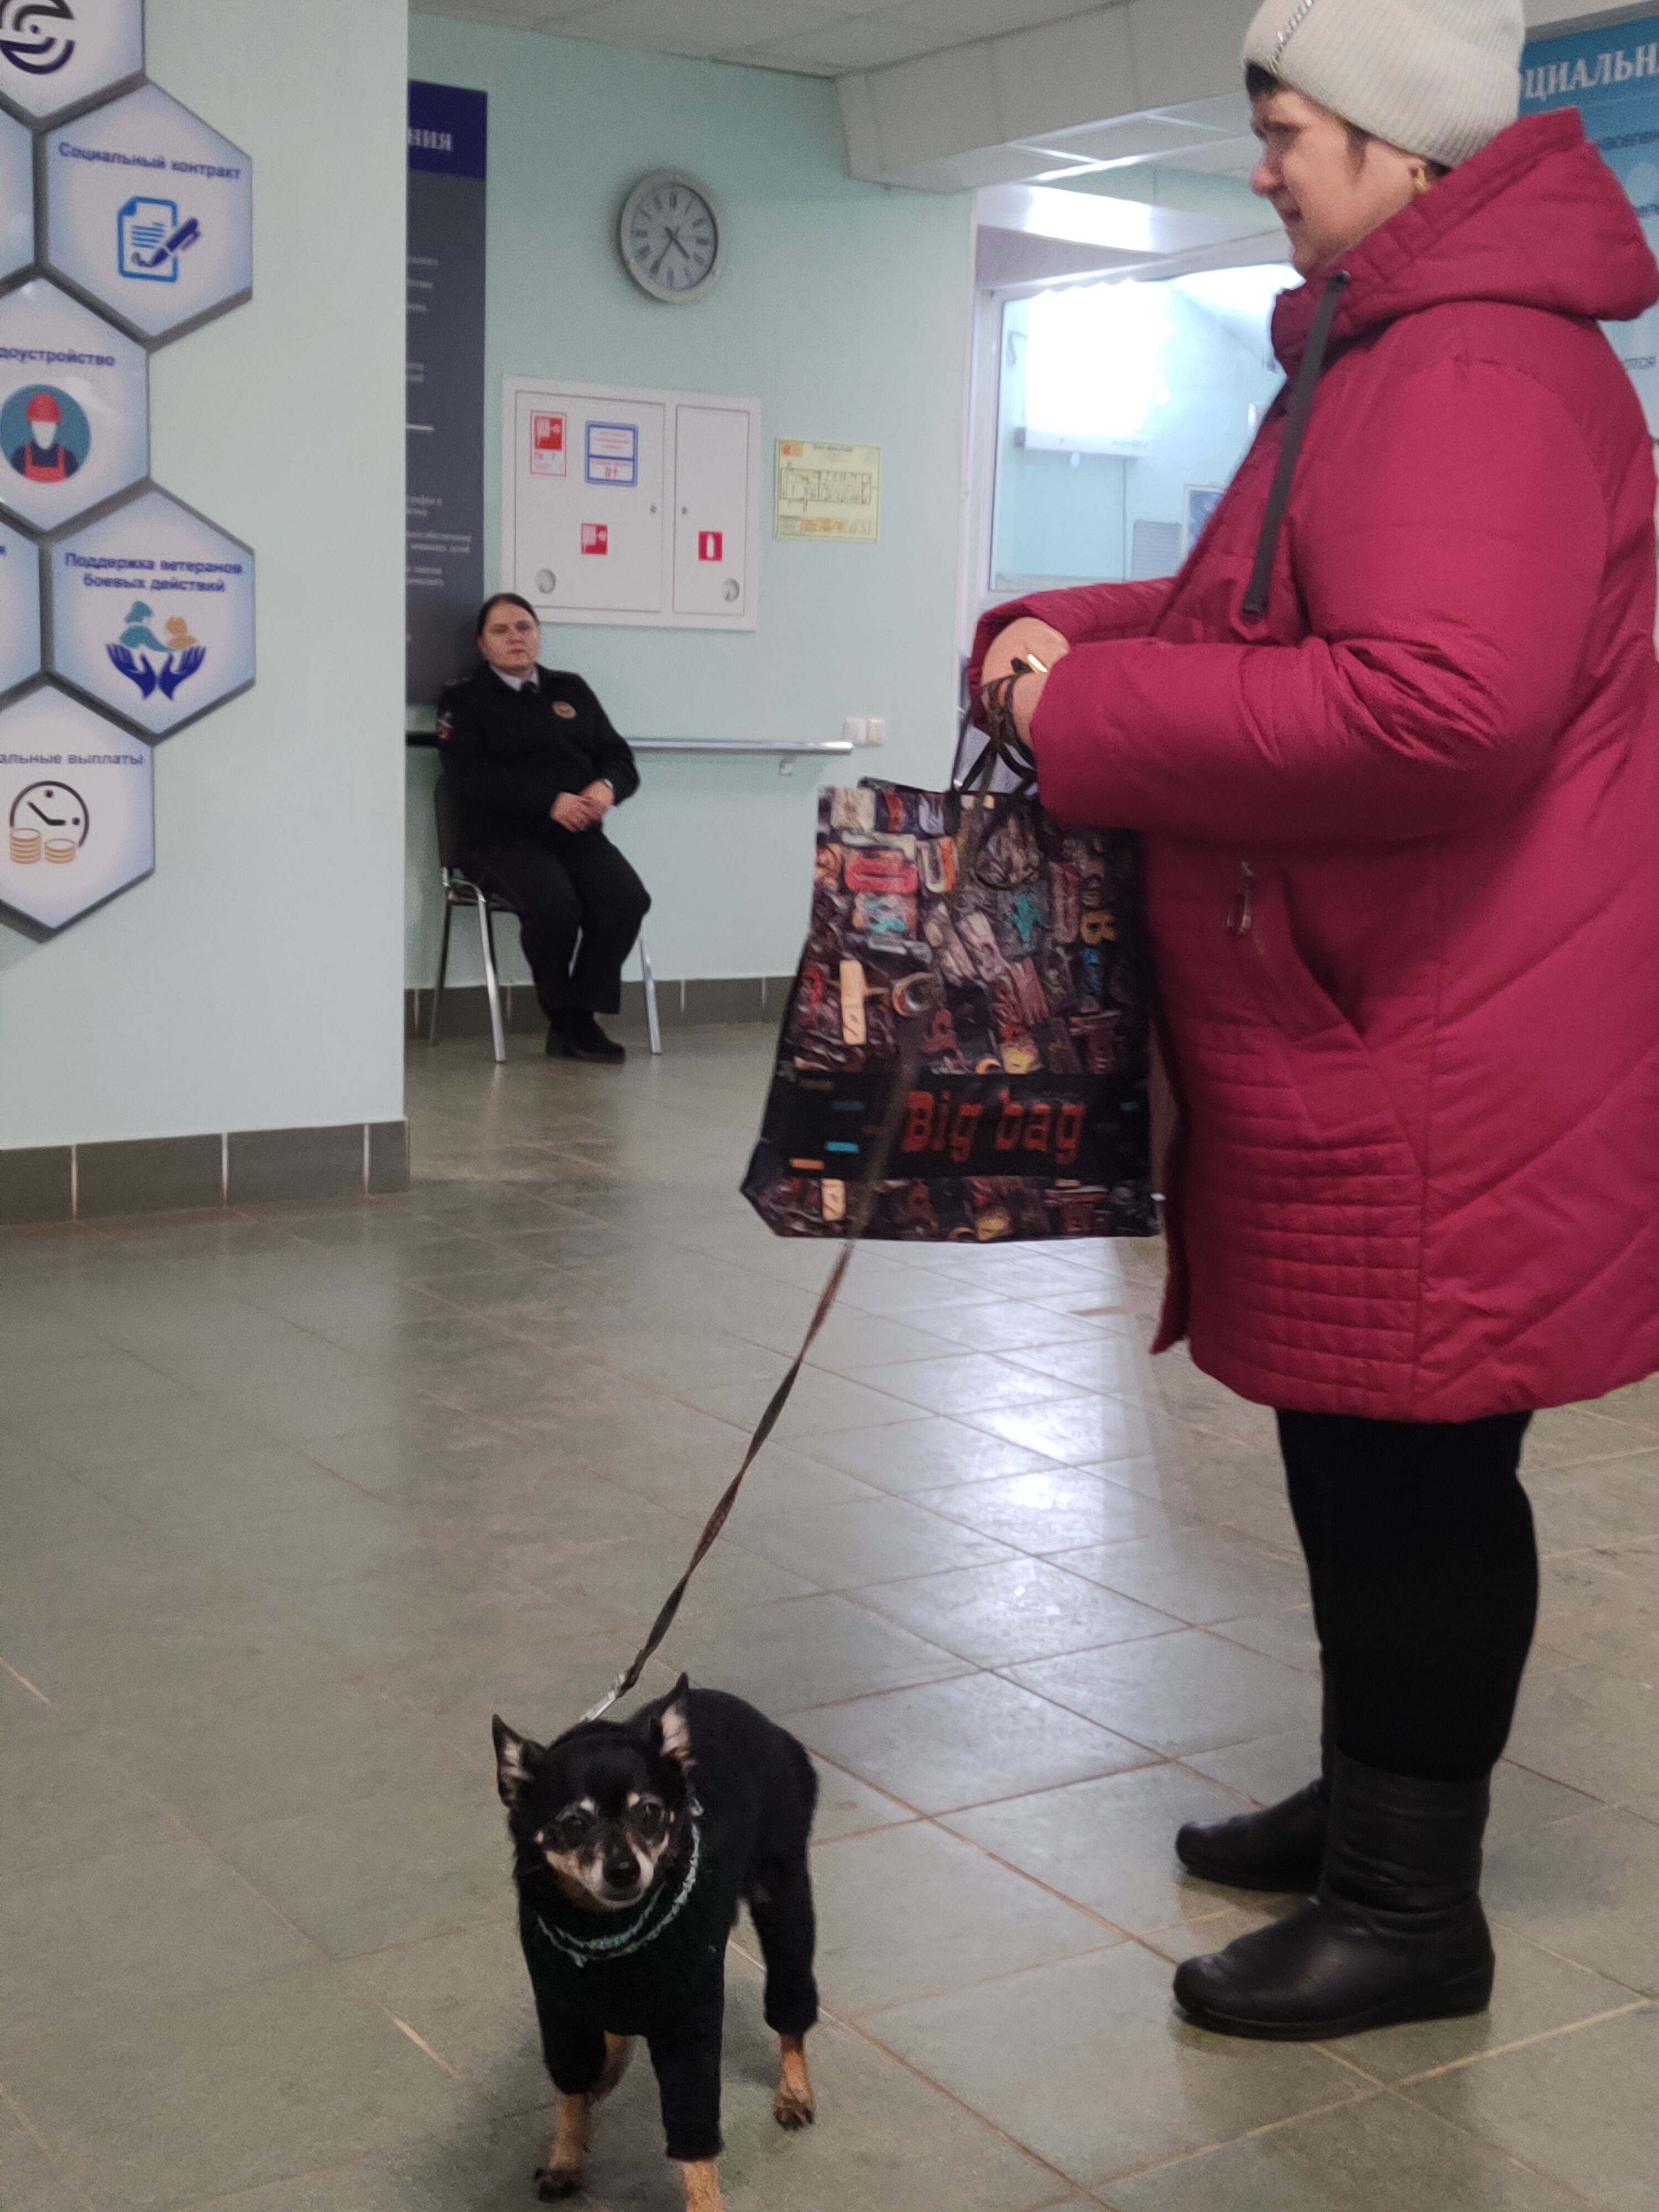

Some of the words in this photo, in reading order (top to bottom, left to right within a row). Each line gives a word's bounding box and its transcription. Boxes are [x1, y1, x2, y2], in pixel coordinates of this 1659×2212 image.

[1520, 40, 1659, 102] ЦИАЛЬН
[58, 142, 165, 169] Социальный
[170, 160, 241, 179] контракт
[65, 552, 155, 571] Поддержка
[160, 560, 243, 575] ветеранов
[84, 573, 145, 588] боевых
[149, 576, 225, 592] действий
[67, 753, 144, 765] выплаты
[901, 1090, 982, 1162] Big
[994, 1088, 1086, 1165] bag
